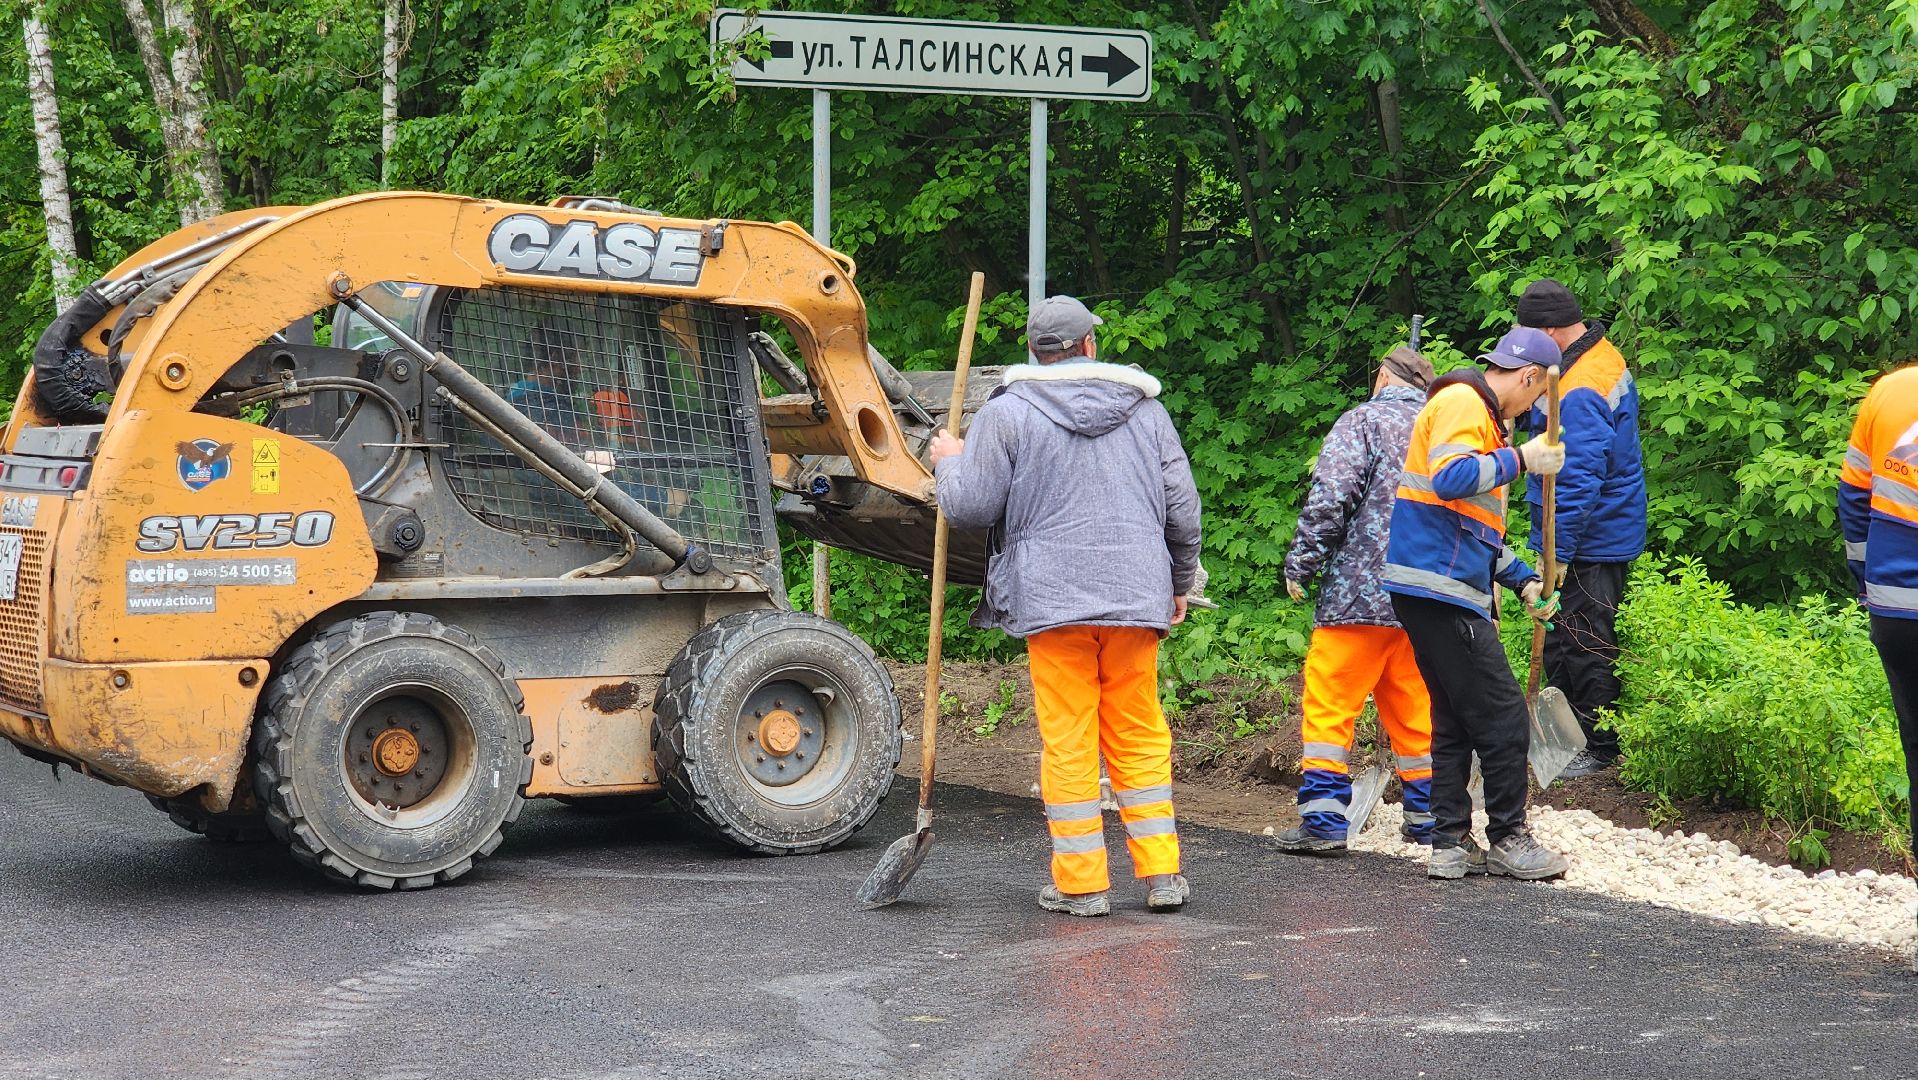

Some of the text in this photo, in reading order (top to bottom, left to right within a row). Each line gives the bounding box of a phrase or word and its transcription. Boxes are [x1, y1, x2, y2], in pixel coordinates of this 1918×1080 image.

[802, 36, 1074, 79] ул. ТАЛСИНСКАЯ
[488, 213, 702, 284] CASE
[3, 495, 38, 522] CASE
[137, 511, 335, 552] SV250
[128, 562, 293, 583] actio (495) 54 500 54
[128, 595, 213, 608] www.actio.ru
